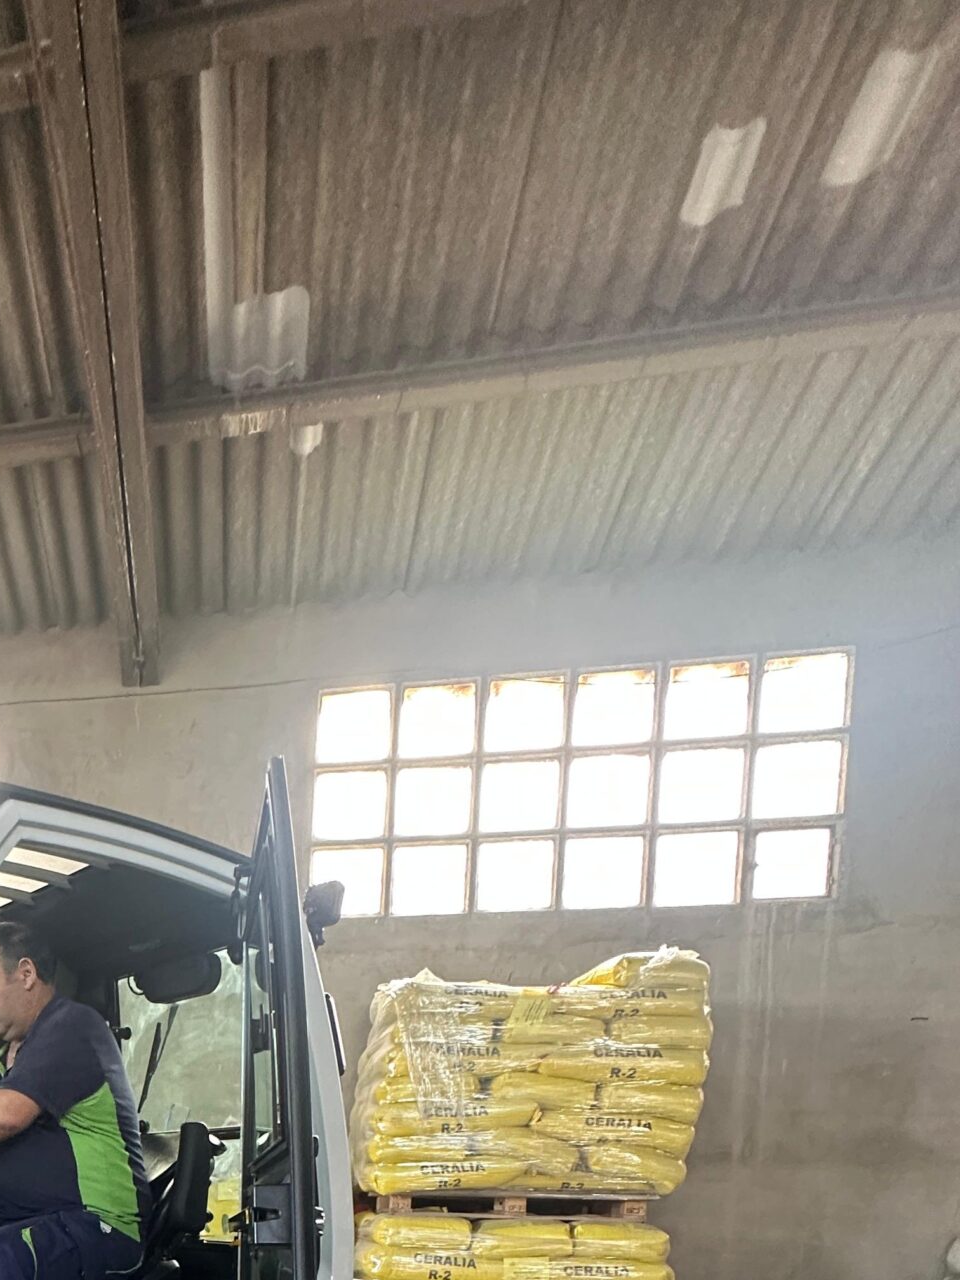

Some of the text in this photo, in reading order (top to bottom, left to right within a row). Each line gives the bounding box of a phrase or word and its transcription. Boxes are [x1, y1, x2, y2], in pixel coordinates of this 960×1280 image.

[609, 1067, 637, 1079] R-2
[423, 1106, 489, 1118] ERLIA
[441, 1123, 464, 1134] R-2
[414, 1252, 477, 1269] CERALIA
[428, 1270, 452, 1280] R-2
[563, 1266, 630, 1277] CERALIA
